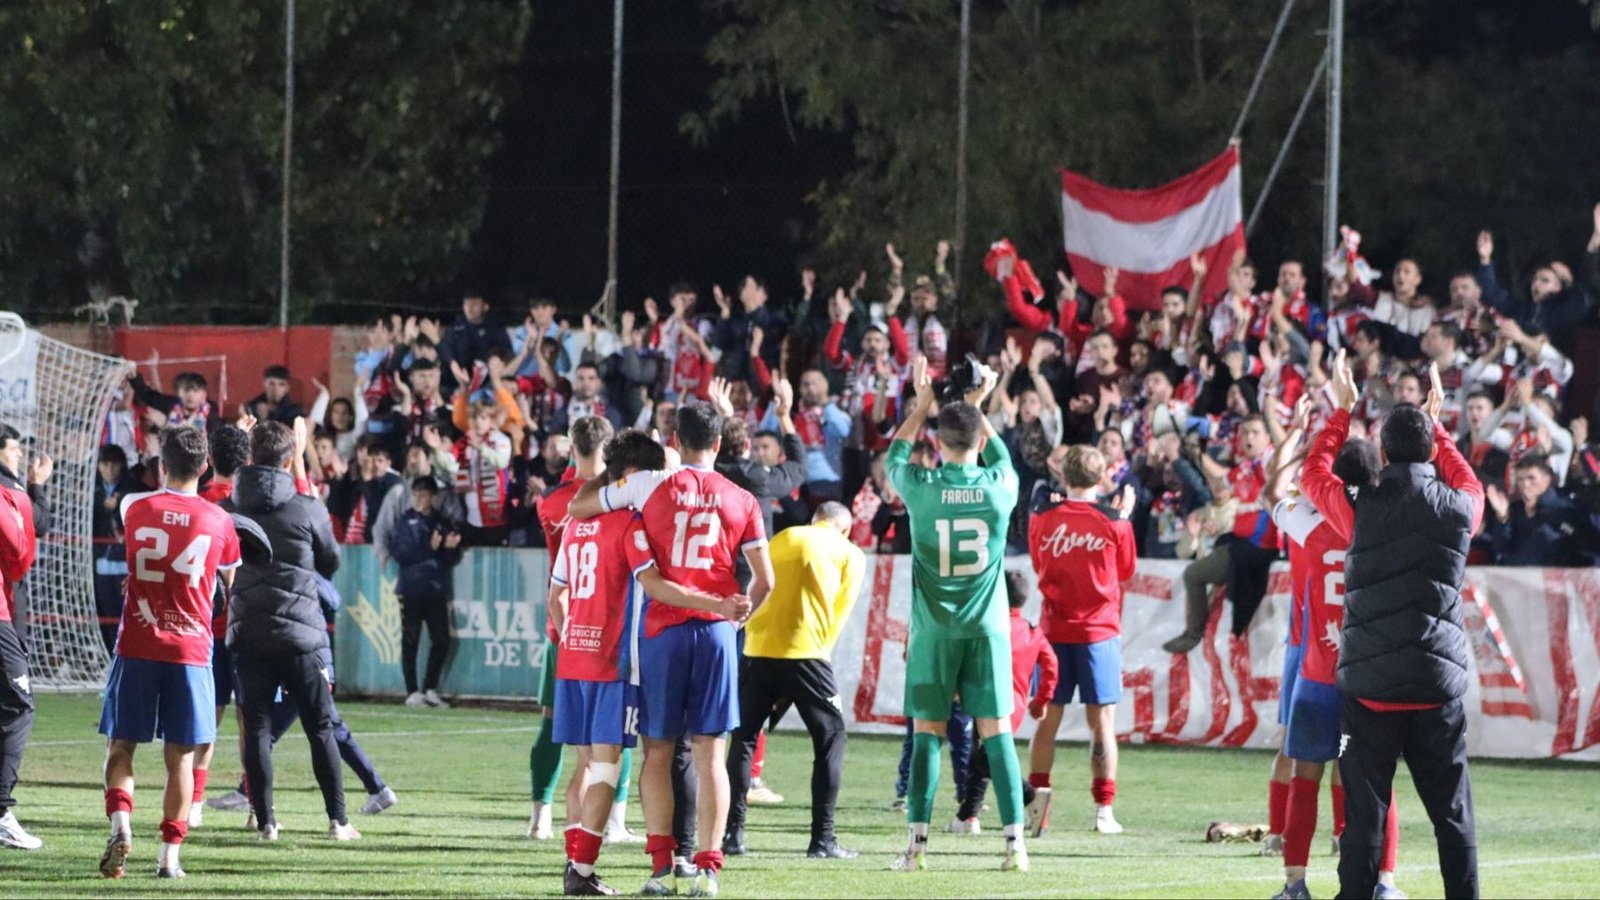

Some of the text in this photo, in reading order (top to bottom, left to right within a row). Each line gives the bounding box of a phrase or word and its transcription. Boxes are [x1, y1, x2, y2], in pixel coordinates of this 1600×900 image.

[676, 491, 721, 508] MANJA
[941, 488, 984, 504] FAROLO
[162, 511, 190, 527] EMI
[671, 510, 721, 570] 12
[935, 517, 990, 577] 13
[135, 526, 212, 589] 24
[568, 541, 599, 599] 18
[164, 613, 201, 624] DUL
[447, 601, 540, 640] CAJA
[484, 642, 521, 667] DE
